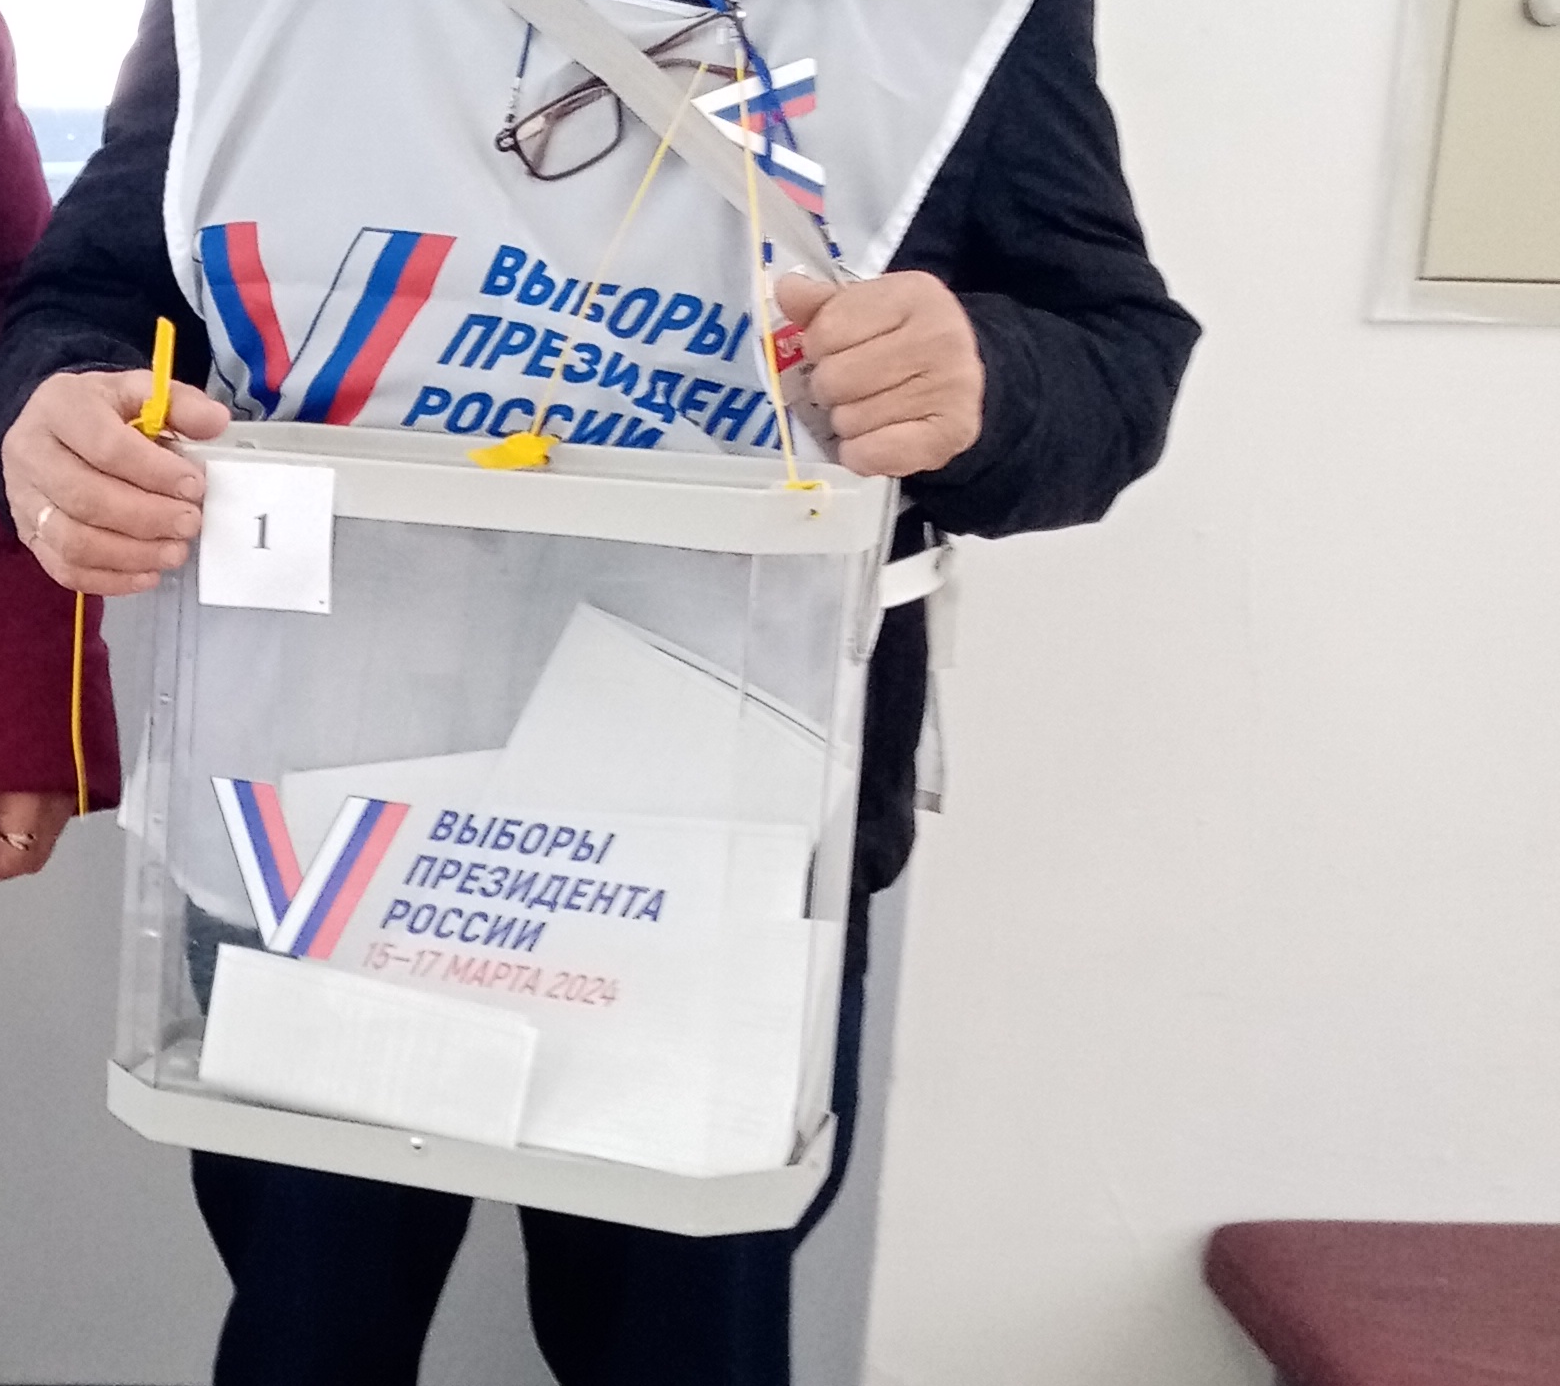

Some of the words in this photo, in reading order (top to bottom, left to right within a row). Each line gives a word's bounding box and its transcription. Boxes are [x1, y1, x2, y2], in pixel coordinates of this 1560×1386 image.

[480, 244, 752, 363] ВЫБОРЫ
[253, 513, 271, 550] 1
[428, 808, 616, 865] ВЫБОРЫ
[402, 854, 668, 923] ПРЕЗИДЕНТА
[379, 899, 549, 953] РОССИИ
[441, 954, 543, 998] МАРТА
[544, 971, 621, 1008] 2024
